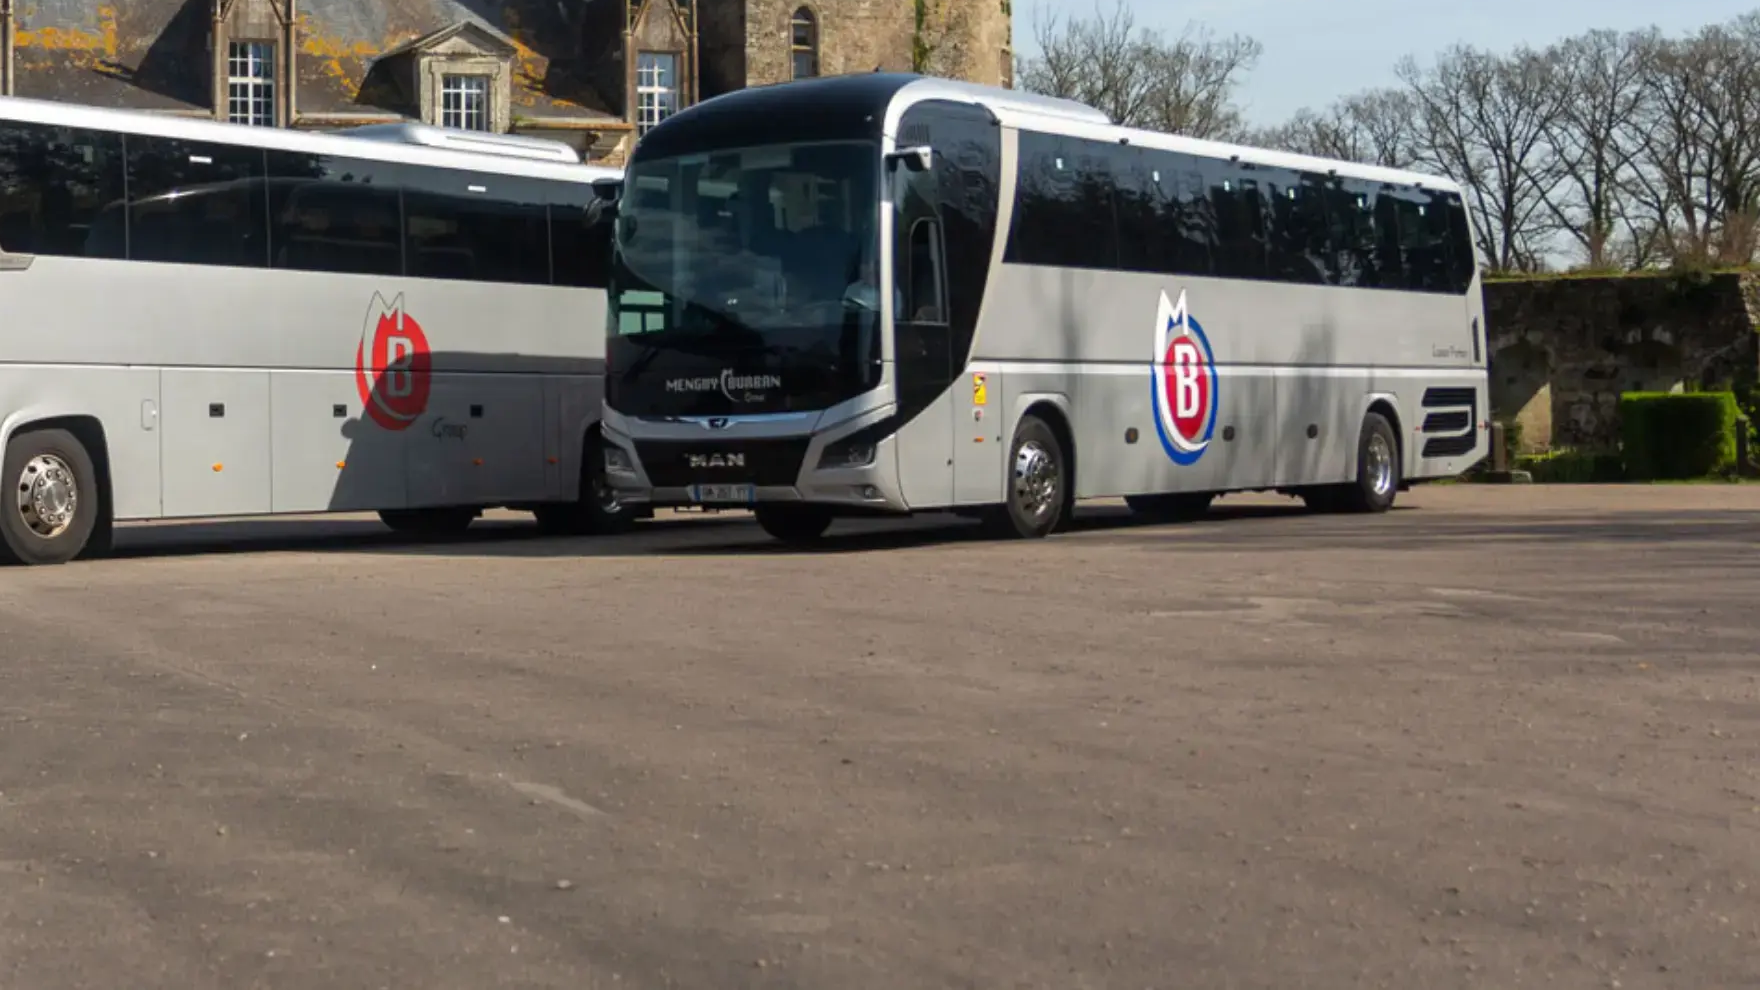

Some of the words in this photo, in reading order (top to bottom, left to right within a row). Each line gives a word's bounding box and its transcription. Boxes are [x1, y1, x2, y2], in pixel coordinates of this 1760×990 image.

[387, 336, 414, 397] B
[1174, 343, 1200, 419] B
[689, 453, 745, 468] MAN
